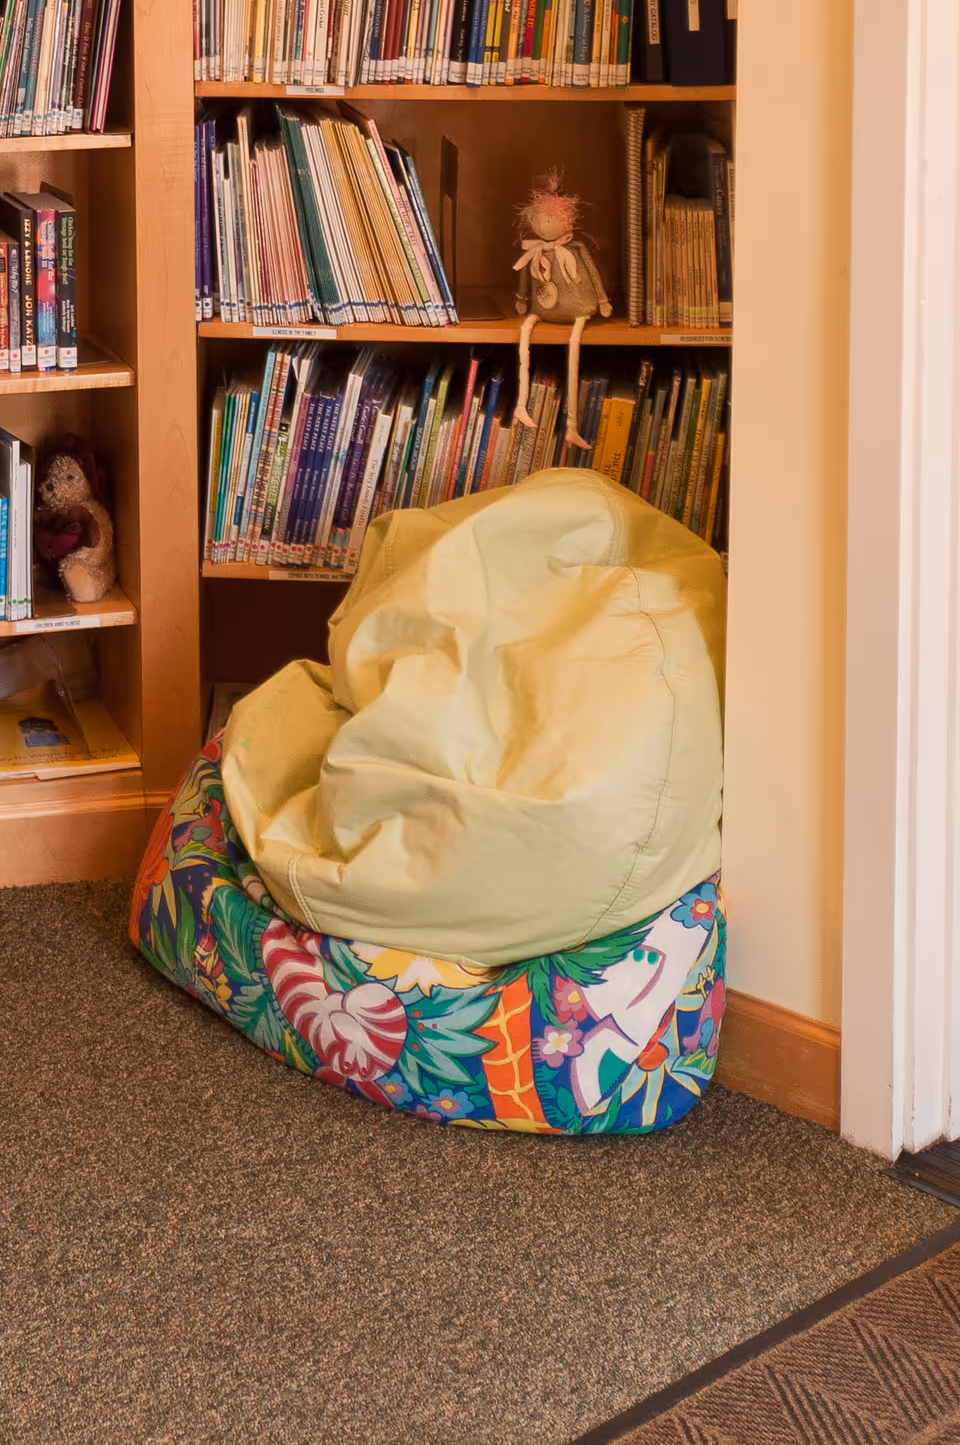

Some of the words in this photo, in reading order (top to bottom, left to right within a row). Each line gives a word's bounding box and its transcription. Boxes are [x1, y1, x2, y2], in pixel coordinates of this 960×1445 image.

[25, 295, 33, 313] JON
[26, 316, 34, 346] KATZ
[330, 416, 338, 430] NEXT
[302, 431, 310, 450] PLACE
[327, 431, 335, 450] PLACE
